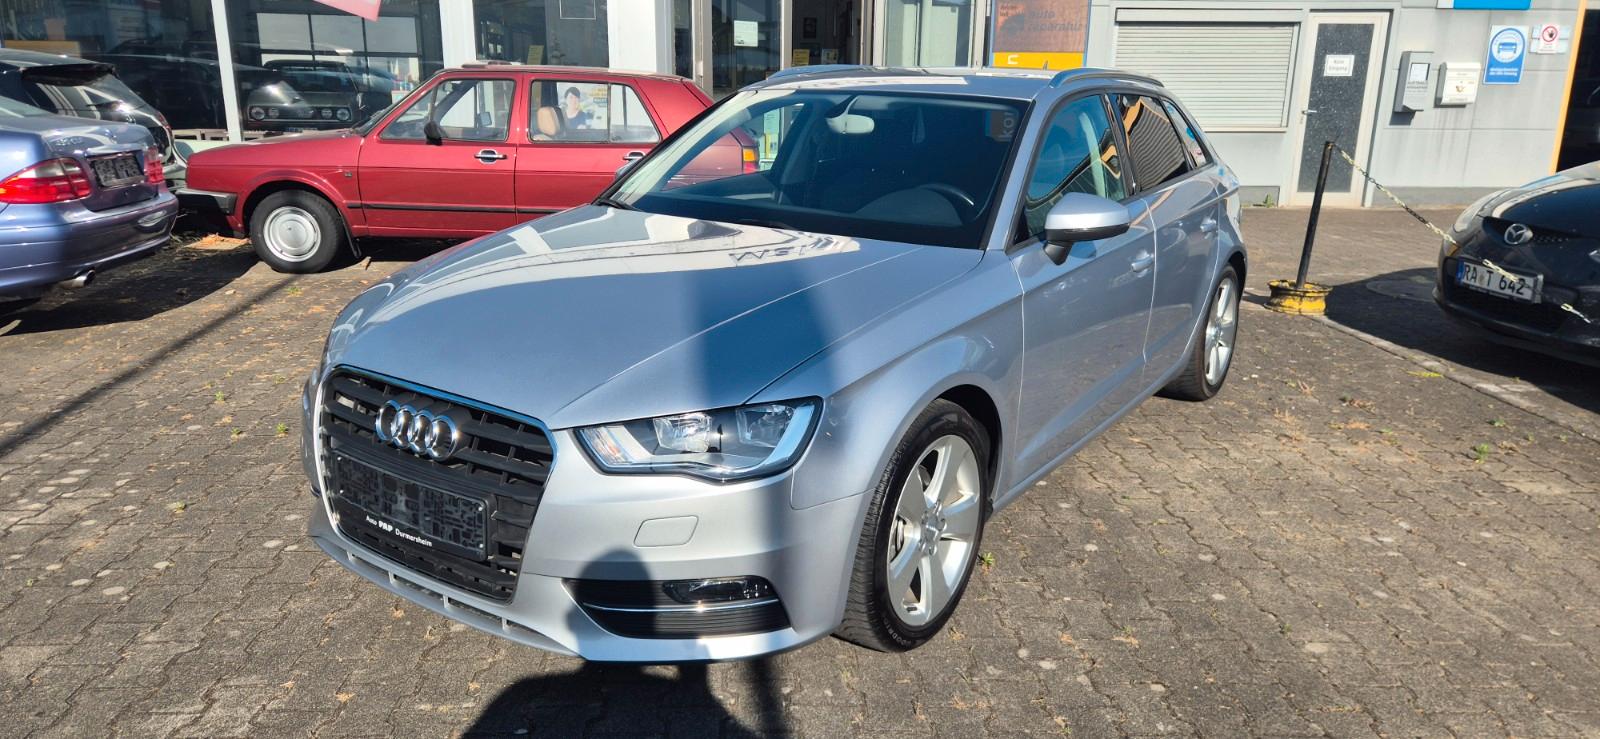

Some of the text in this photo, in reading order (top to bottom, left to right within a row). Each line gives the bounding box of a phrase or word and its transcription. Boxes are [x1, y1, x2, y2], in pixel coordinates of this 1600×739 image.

[1463, 264, 1478, 283] RA
[1486, 270, 1494, 287] T
[1499, 275, 1526, 295] 642
[378, 520, 393, 532] PAP
[395, 528, 433, 547] Durmersheim
